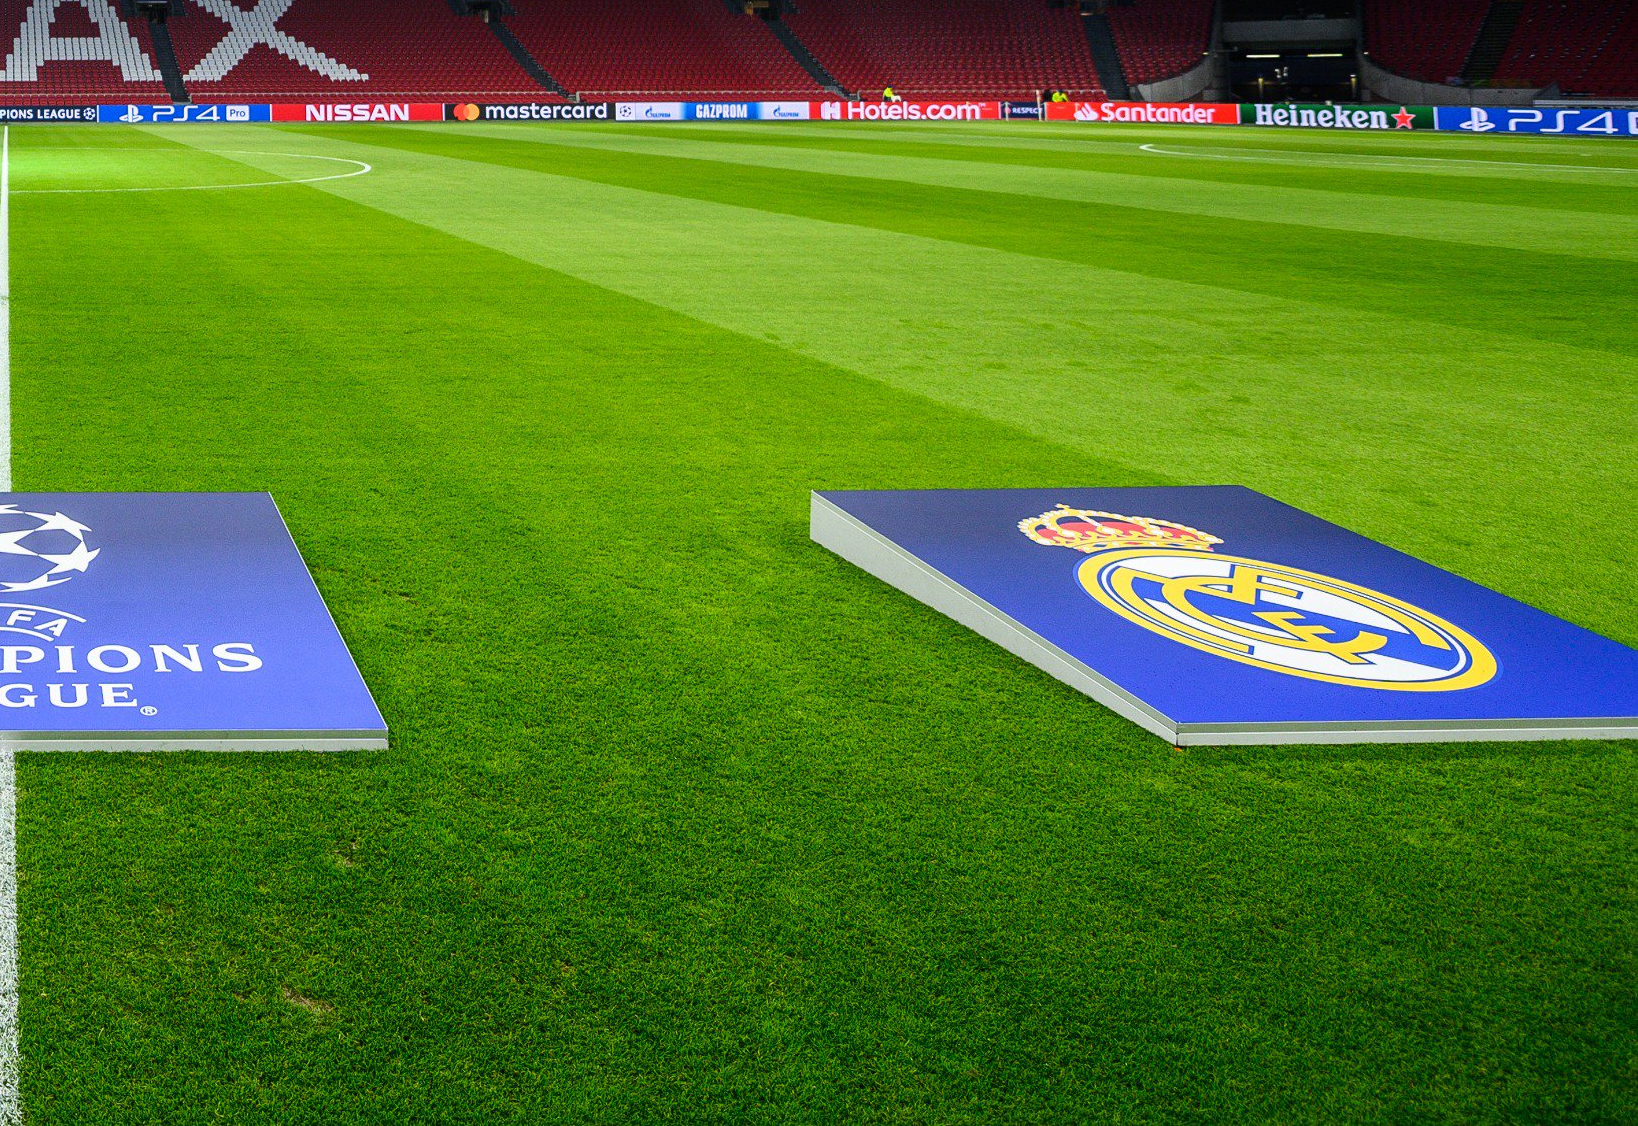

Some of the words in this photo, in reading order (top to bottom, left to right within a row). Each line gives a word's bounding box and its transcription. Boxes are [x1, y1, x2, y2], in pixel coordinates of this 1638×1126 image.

[37, 109, 81, 120] LEAGUE
[152, 105, 221, 121] PS4
[230, 108, 246, 118] Pro
[305, 104, 409, 121] NISSAN
[485, 103, 607, 119] mastercard
[695, 104, 748, 119] GAZPROM
[1100, 103, 1215, 124] Santander
[1255, 104, 1389, 129] Heineken
[1507, 109, 1619, 134] PS4
